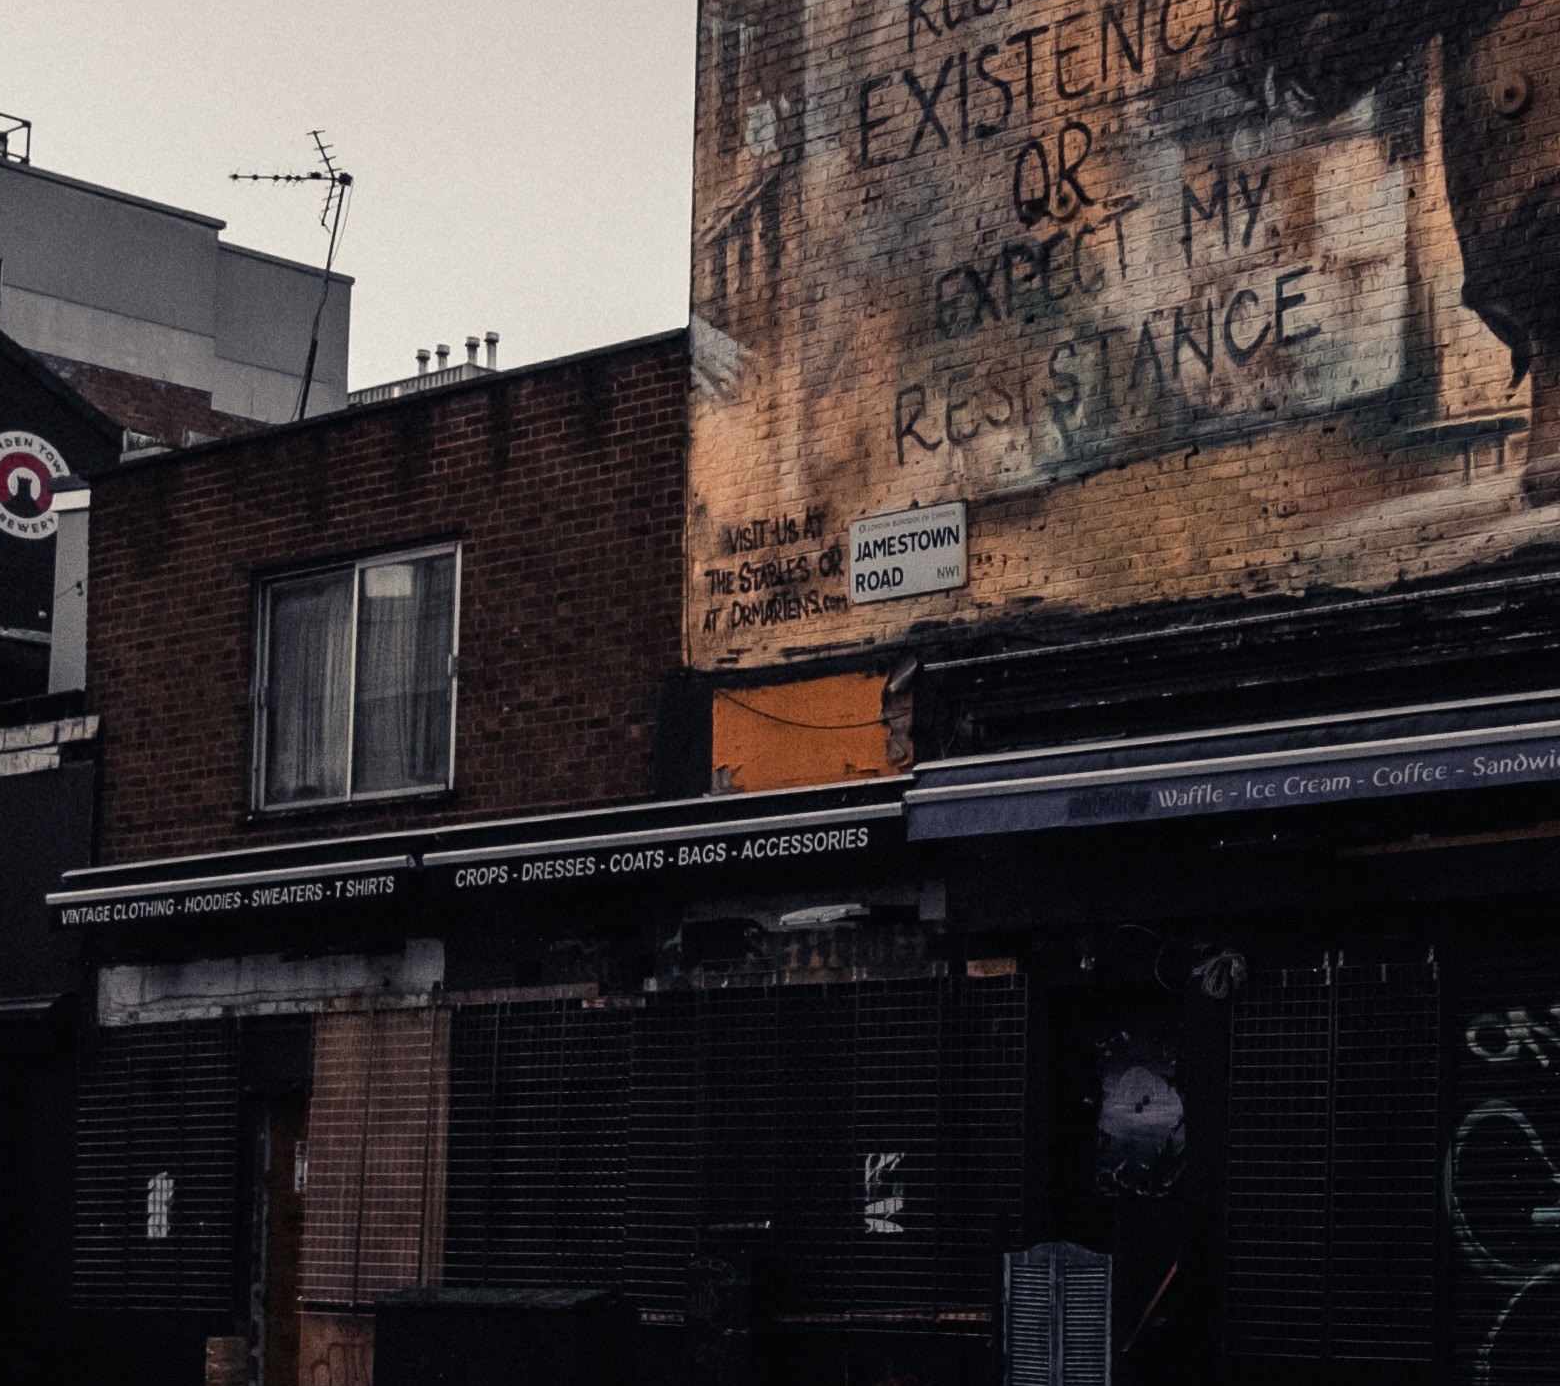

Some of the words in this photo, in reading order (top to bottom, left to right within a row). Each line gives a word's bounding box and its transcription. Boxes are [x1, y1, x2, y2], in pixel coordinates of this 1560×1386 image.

[1013, 122, 1095, 227] OR
[937, 194, 1141, 340] EXPECT
[1181, 164, 1271, 267] MY
[726, 519, 770, 553] VISIT
[854, 525, 960, 563] JAMESTOWN
[704, 568, 735, 596] THE
[740, 557, 811, 593] STABLES
[855, 567, 904, 593] ROAD
[937, 565, 960, 579] NW1
[1158, 783, 1224, 808] Waffle
[1245, 780, 1277, 799] Ice
[1283, 774, 1351, 797] Cream
[1372, 762, 1448, 788] Coffee
[455, 864, 508, 888] CROPS
[521, 857, 596, 881] DRESSES
[609, 849, 664, 873] COATS
[678, 843, 727, 865] BAGS
[740, 827, 870, 860] ACCESSORIES
[61, 905, 112, 926] VINTAGE
[113, 899, 175, 921] CLOTHING
[184, 893, 242, 913] HOODIES
[251, 884, 323, 908] SWEATERS
[334, 881, 343, 898] T
[345, 876, 395, 897] SHIRTS
